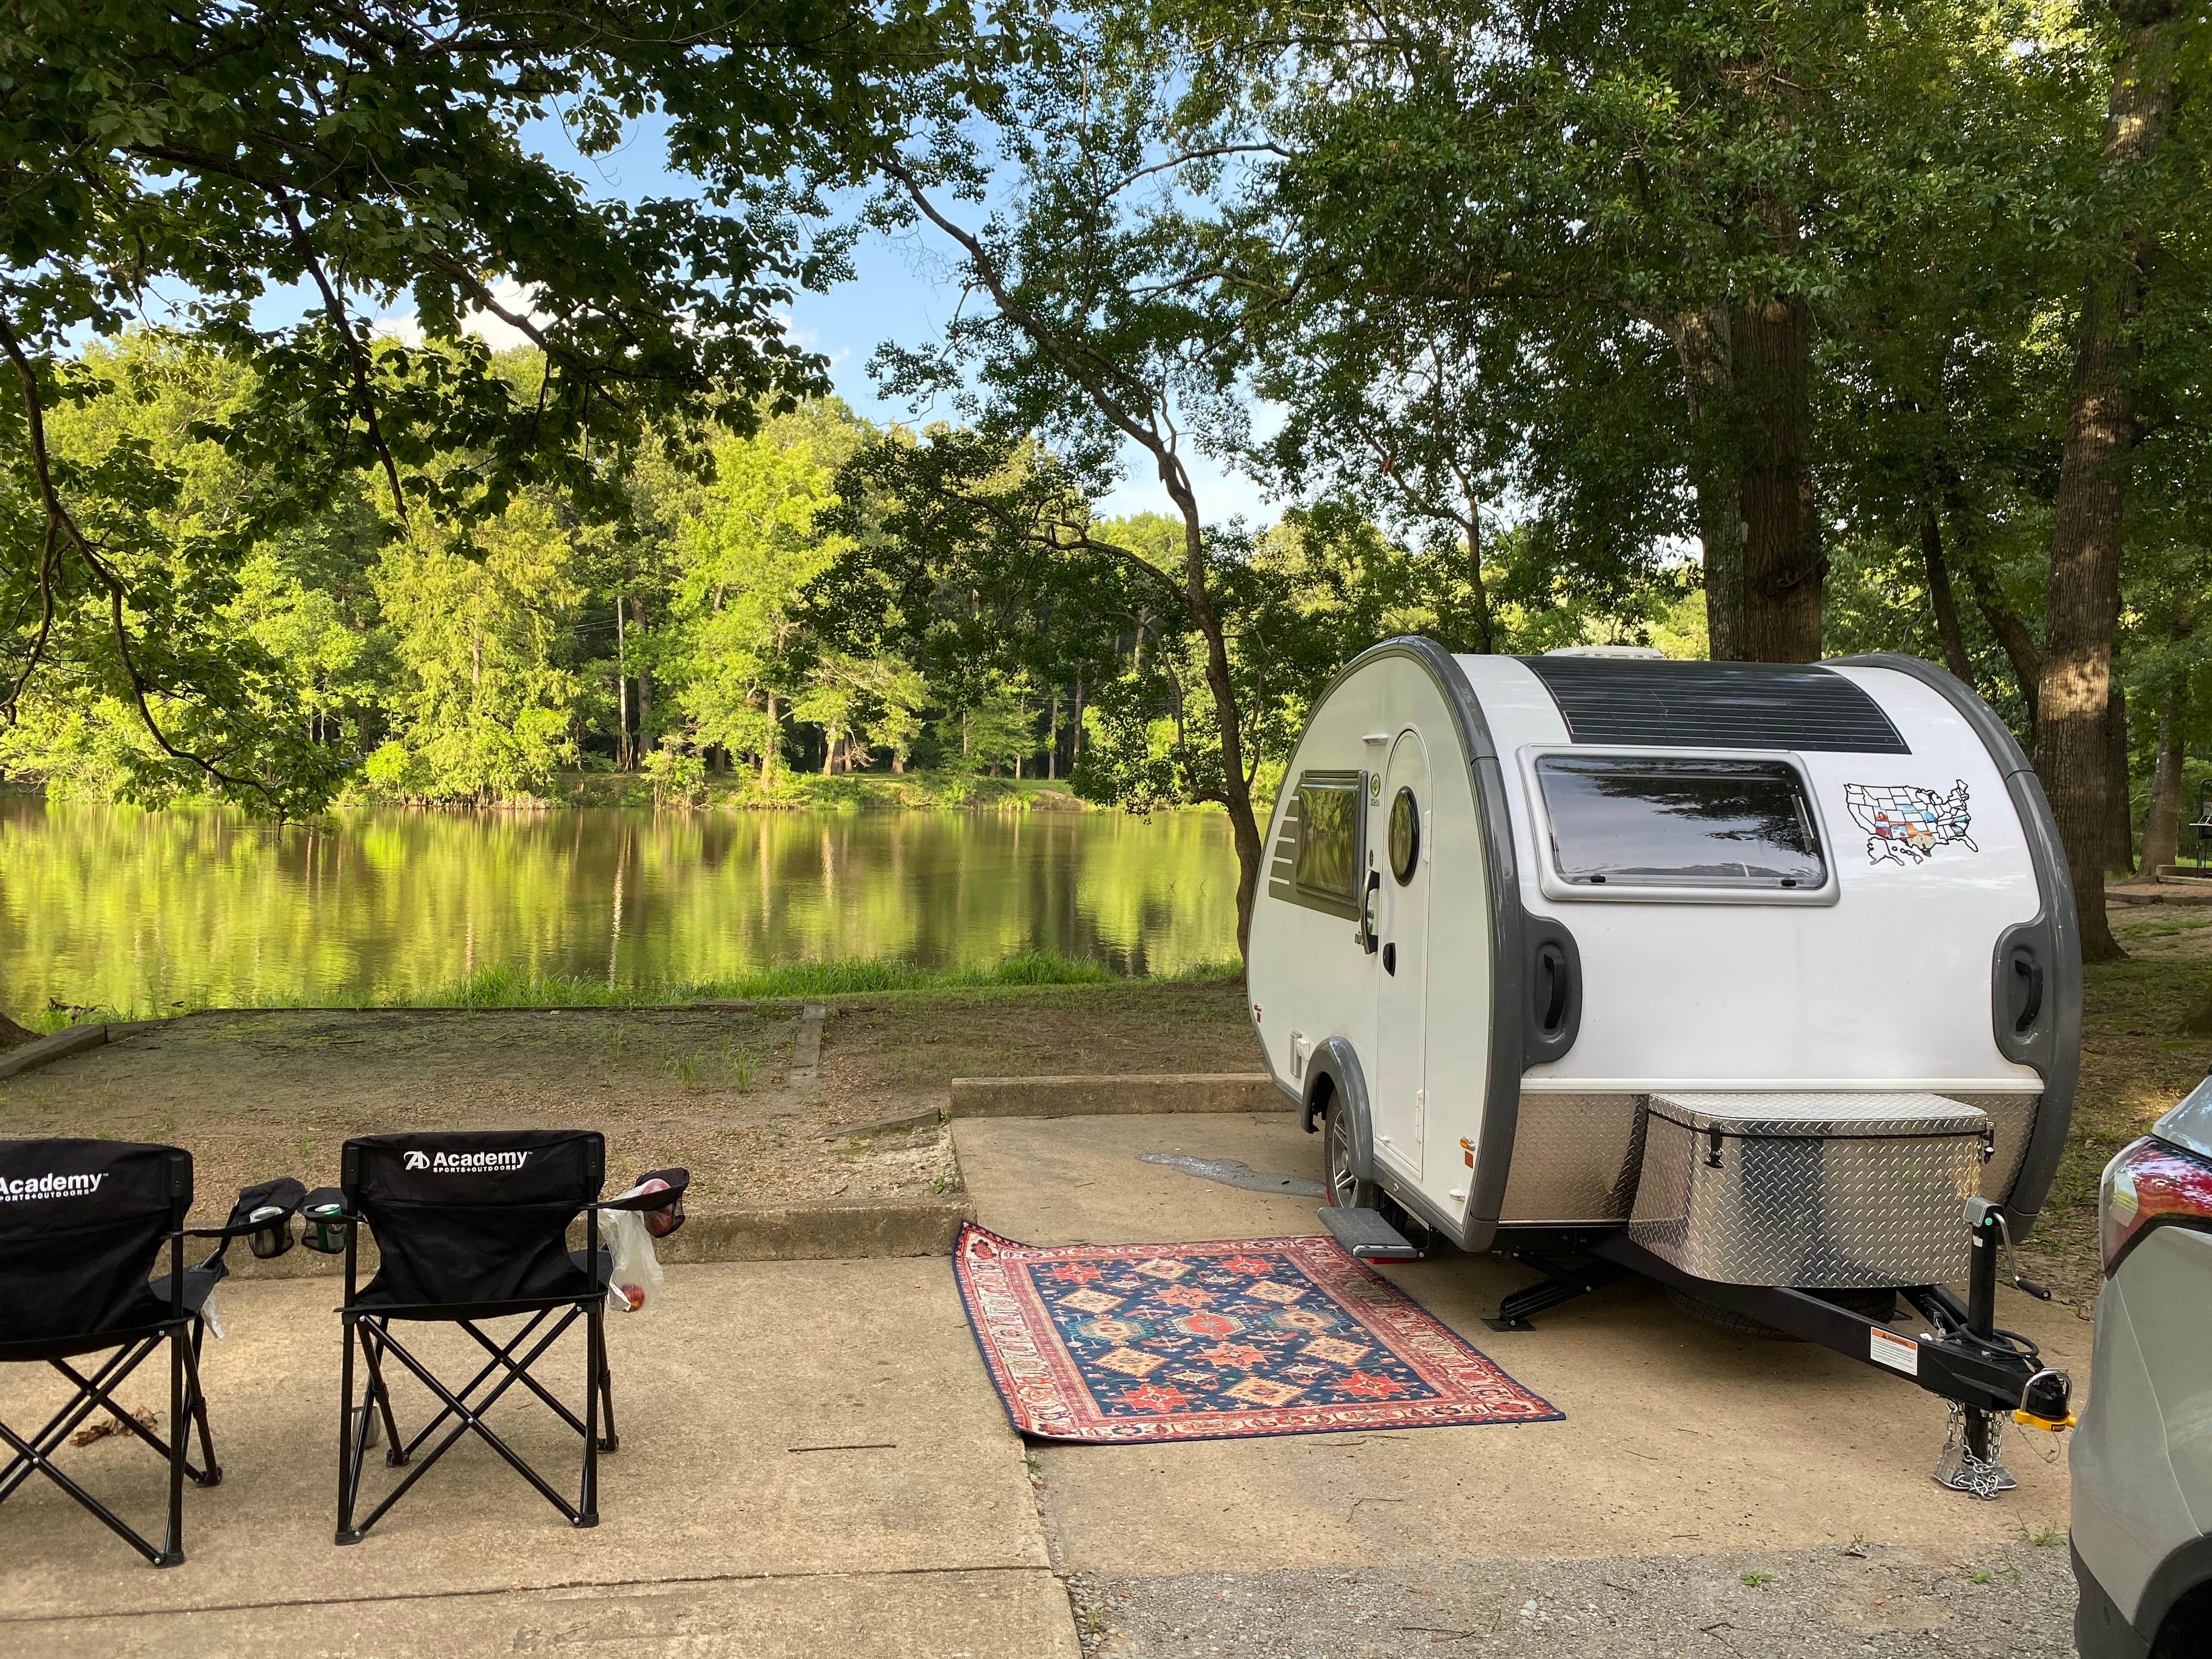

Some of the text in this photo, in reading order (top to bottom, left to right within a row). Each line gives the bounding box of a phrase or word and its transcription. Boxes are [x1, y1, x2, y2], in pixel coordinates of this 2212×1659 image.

[433, 1151, 528, 1169] Academy
[0, 1173, 102, 1195] Academy
[0, 1189, 89, 1201] PORTS+OUTDOORS
[1888, 1335, 1908, 1346] WARNING
